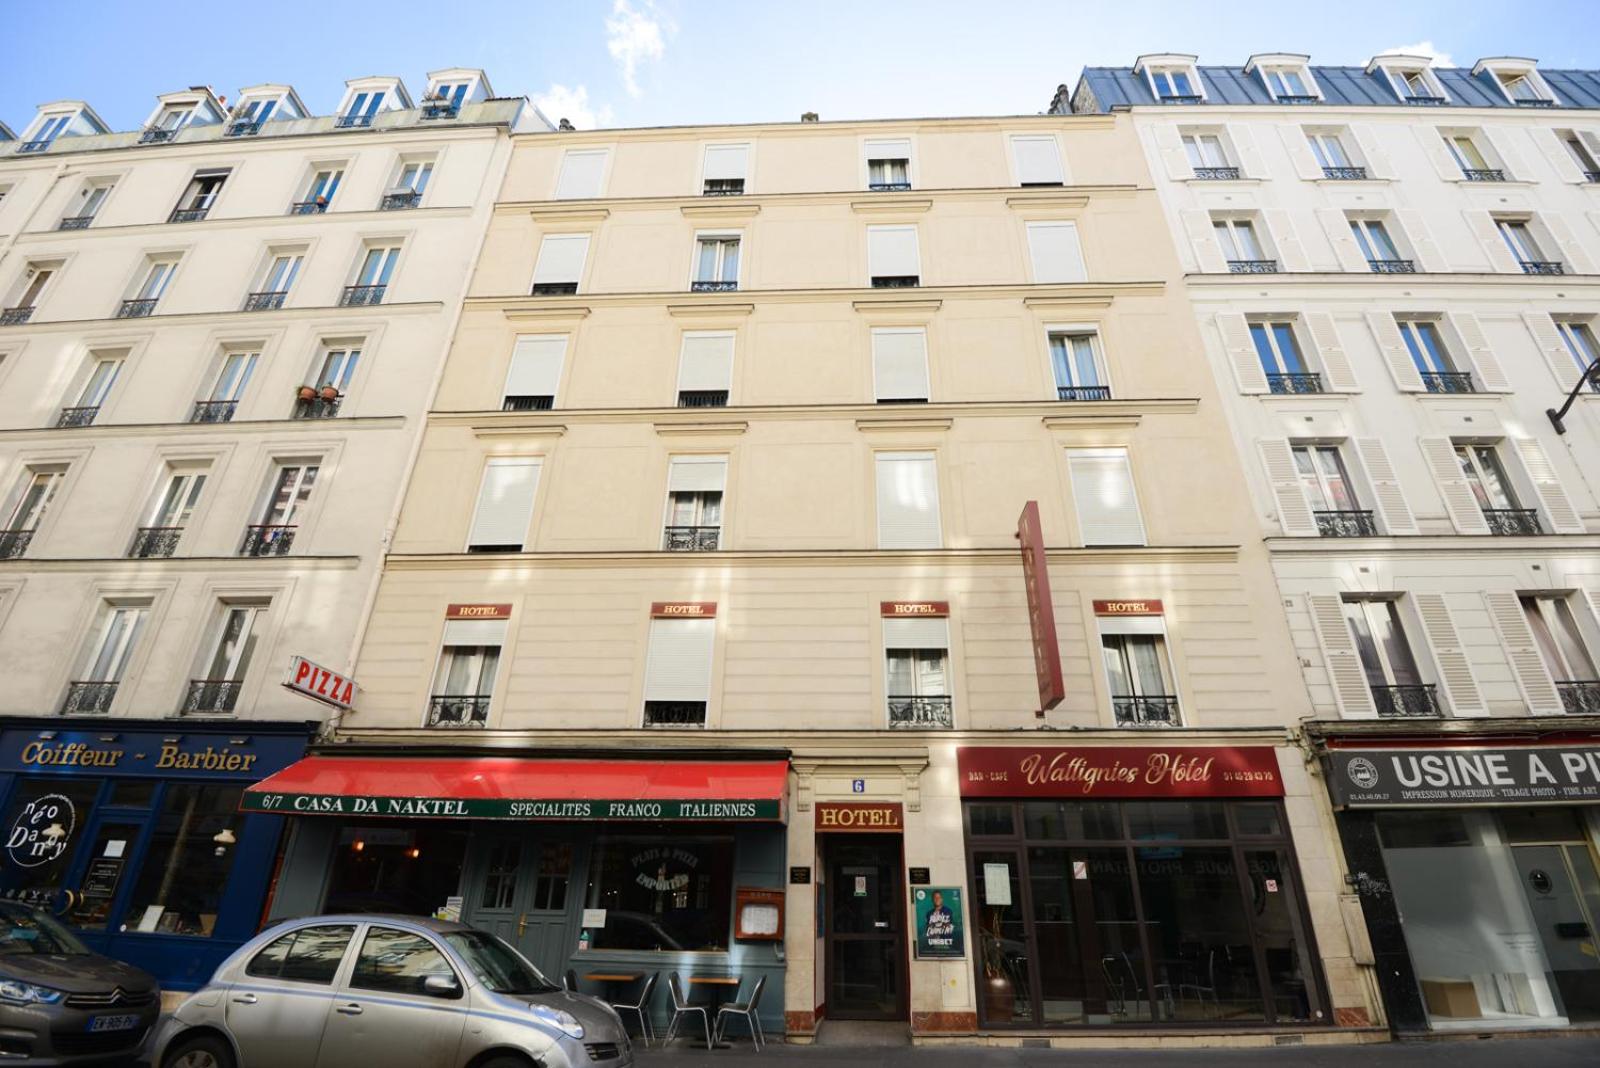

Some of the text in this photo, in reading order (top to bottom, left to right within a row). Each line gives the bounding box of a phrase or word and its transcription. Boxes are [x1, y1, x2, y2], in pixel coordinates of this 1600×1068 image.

[459, 606, 498, 616] HOTEL
[663, 605, 704, 614] HOTEL
[894, 604, 937, 613] HOTEL
[1106, 602, 1151, 612] HOTEL
[295, 661, 353, 705] PIZZA
[21, 741, 123, 767] Coiffeur
[155, 744, 257, 772] Barbier
[1020, 752, 1215, 794] Wattignies Hôtel
[1391, 754, 1516, 788] USINE
[1529, 753, 1559, 784] A
[855, 781, 862, 792] 6
[1400, 789, 1449, 800] IMPRESSION
[1501, 788, 1530, 798] TIRAGE
[1530, 787, 1556, 797] PHOTO
[262, 794, 469, 815] 6/7 CASA DA NAKTEL
[509, 802, 756, 817] SPECIALITES FRANCO ITALIENNES
[24, 802, 59, 825] néo
[820, 808, 898, 826] HOTEL
